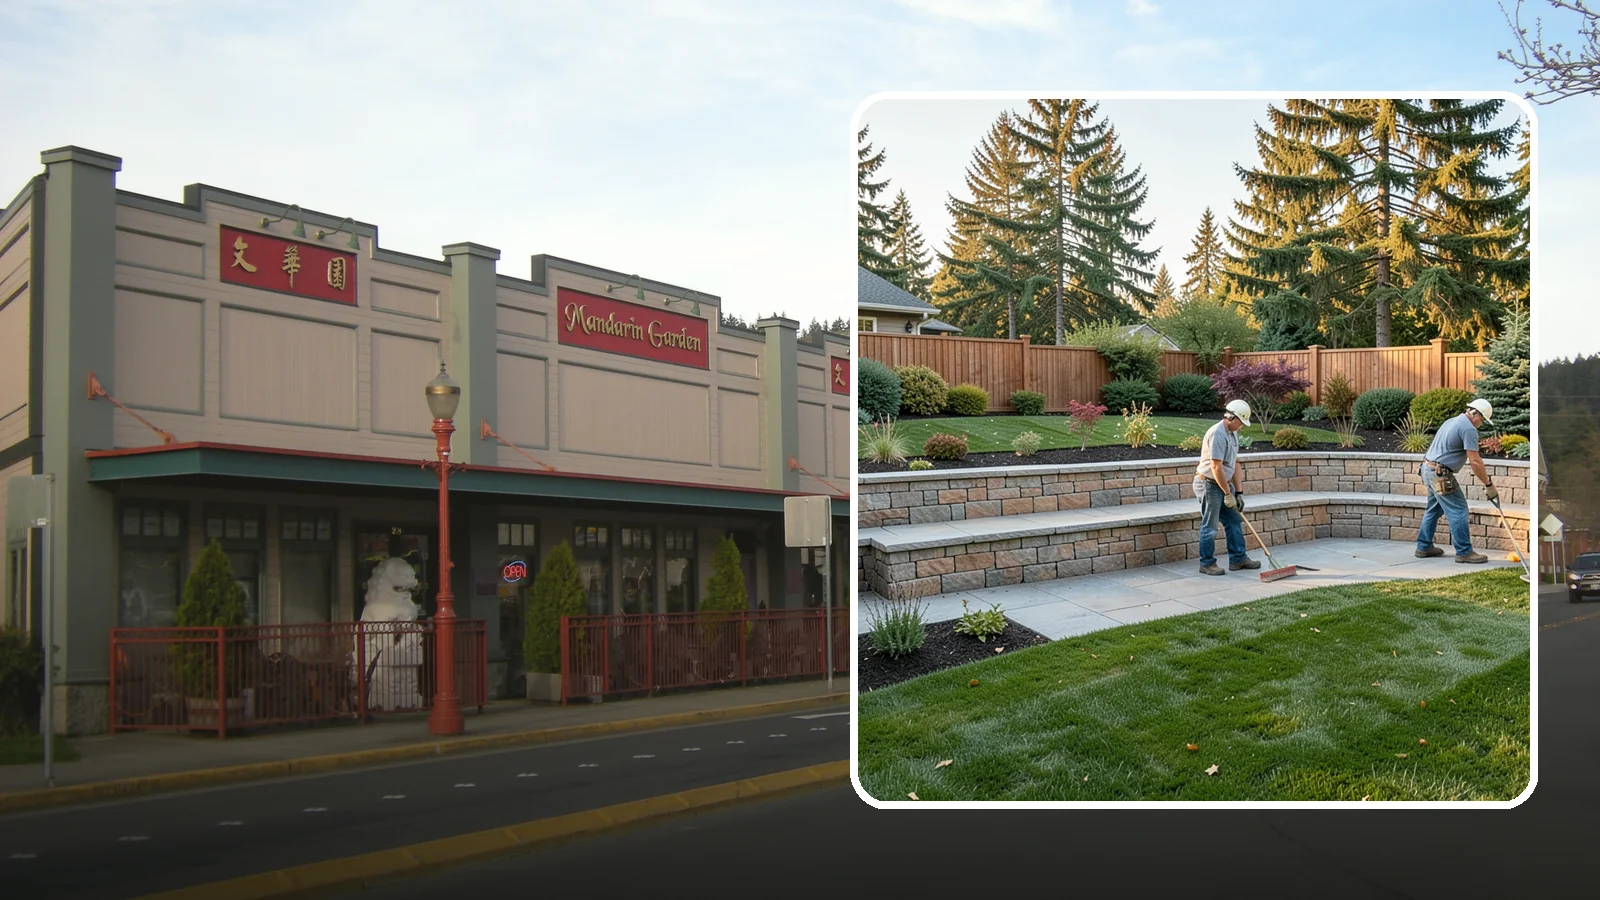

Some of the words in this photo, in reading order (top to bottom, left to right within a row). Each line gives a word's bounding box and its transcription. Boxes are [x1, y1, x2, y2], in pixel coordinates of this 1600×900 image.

[231, 236, 346, 291] 文華園
[565, 302, 644, 341] Mandarin
[648, 320, 702, 352] Garden
[504, 565, 527, 578] OPEN
